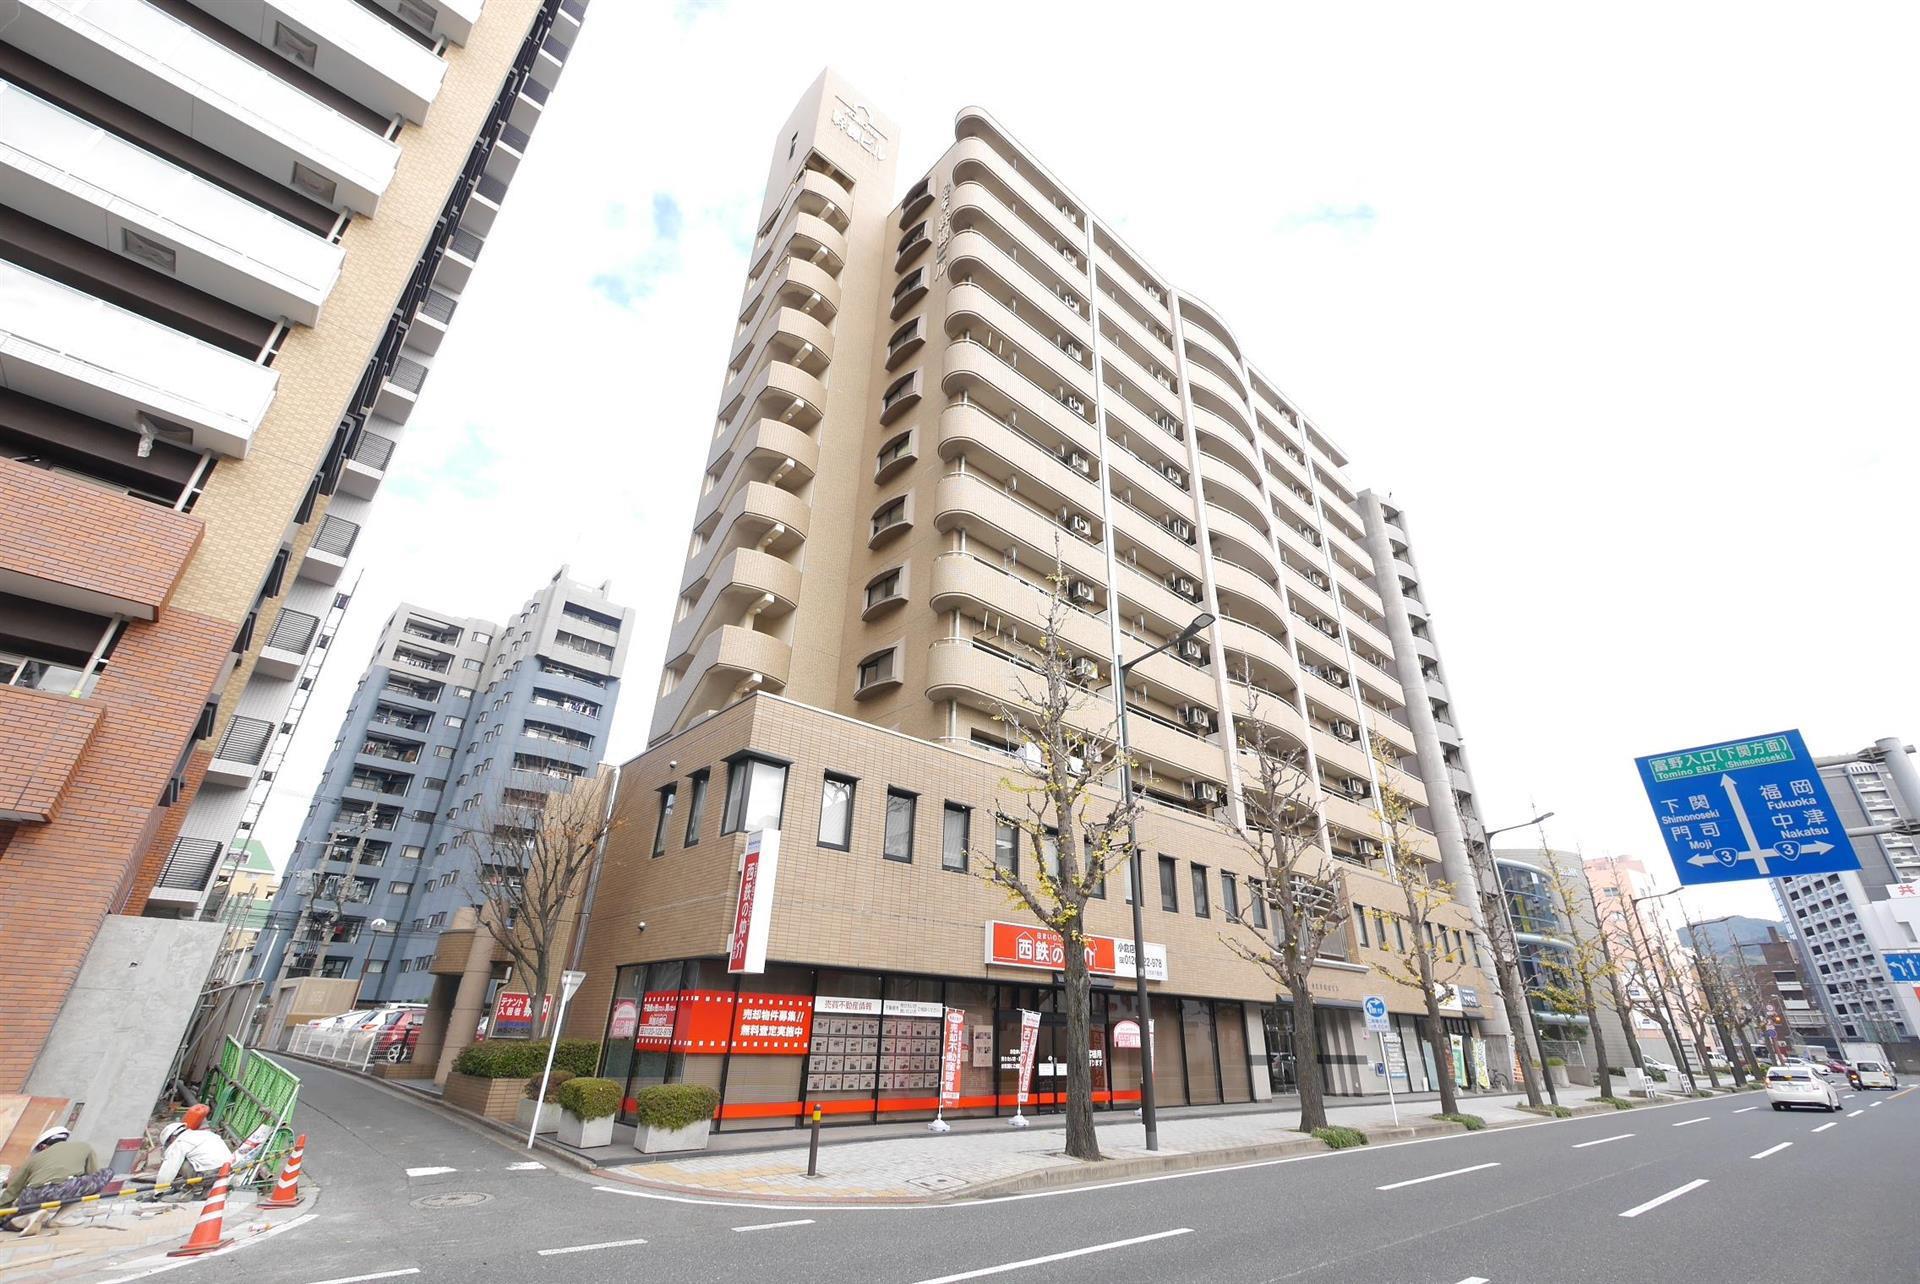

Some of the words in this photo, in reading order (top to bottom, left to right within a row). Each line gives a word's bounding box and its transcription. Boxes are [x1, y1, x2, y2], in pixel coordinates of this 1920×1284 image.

[1652, 738, 1788, 772] 富野入口(下関方面)
[1657, 768, 1694, 780] Tomino
[1696, 763, 1722, 773] ENT.
[1725, 752, 1788, 769] (Shimonoseki)
[1759, 779, 1814, 801] 福岡
[1660, 794, 1711, 815] 下関
[1767, 796, 1817, 811] Fukuoka
[1661, 810, 1720, 825] Shimonoseki
[1772, 809, 1828, 831] 中津
[1671, 821, 1721, 842] 門司
[1780, 826, 1830, 840] Nakatsu
[1689, 840, 1713, 851] Moji
[1782, 844, 1795, 856] 3
[1721, 851, 1733, 862] 3
[734, 862, 756, 960] 西鉄の仲介
[1018, 938, 1097, 966] 西鉄の介
[1124, 954, 1163, 969] 01222-978
[500, 997, 524, 1007] テナント
[740, 1024, 804, 1038] 無料査定実施中
